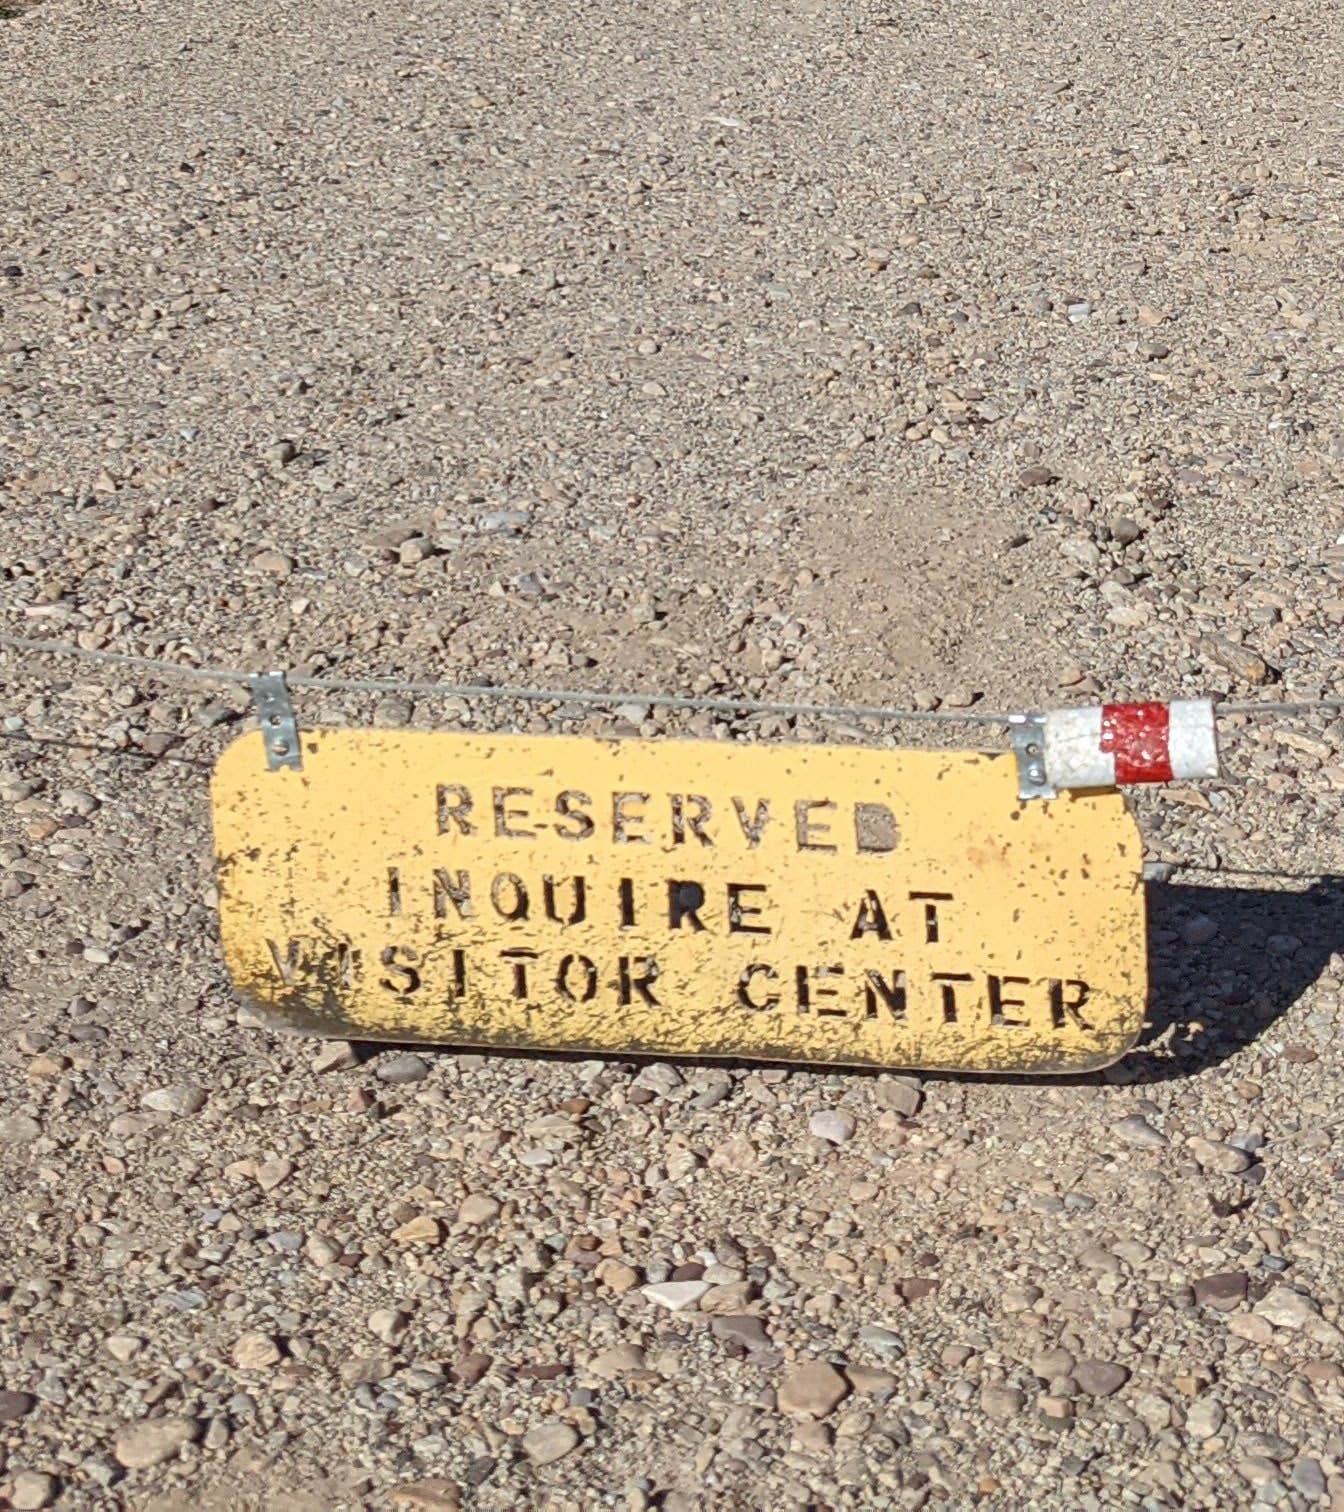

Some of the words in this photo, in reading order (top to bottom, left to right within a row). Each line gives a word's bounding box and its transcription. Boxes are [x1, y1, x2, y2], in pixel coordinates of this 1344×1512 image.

[436, 783, 901, 854] RESERVED
[388, 866, 772, 935] INQUIRE
[850, 889, 953, 943] AT
[265, 938, 662, 1007] VISITOR
[737, 963, 1094, 1030] CENTER
